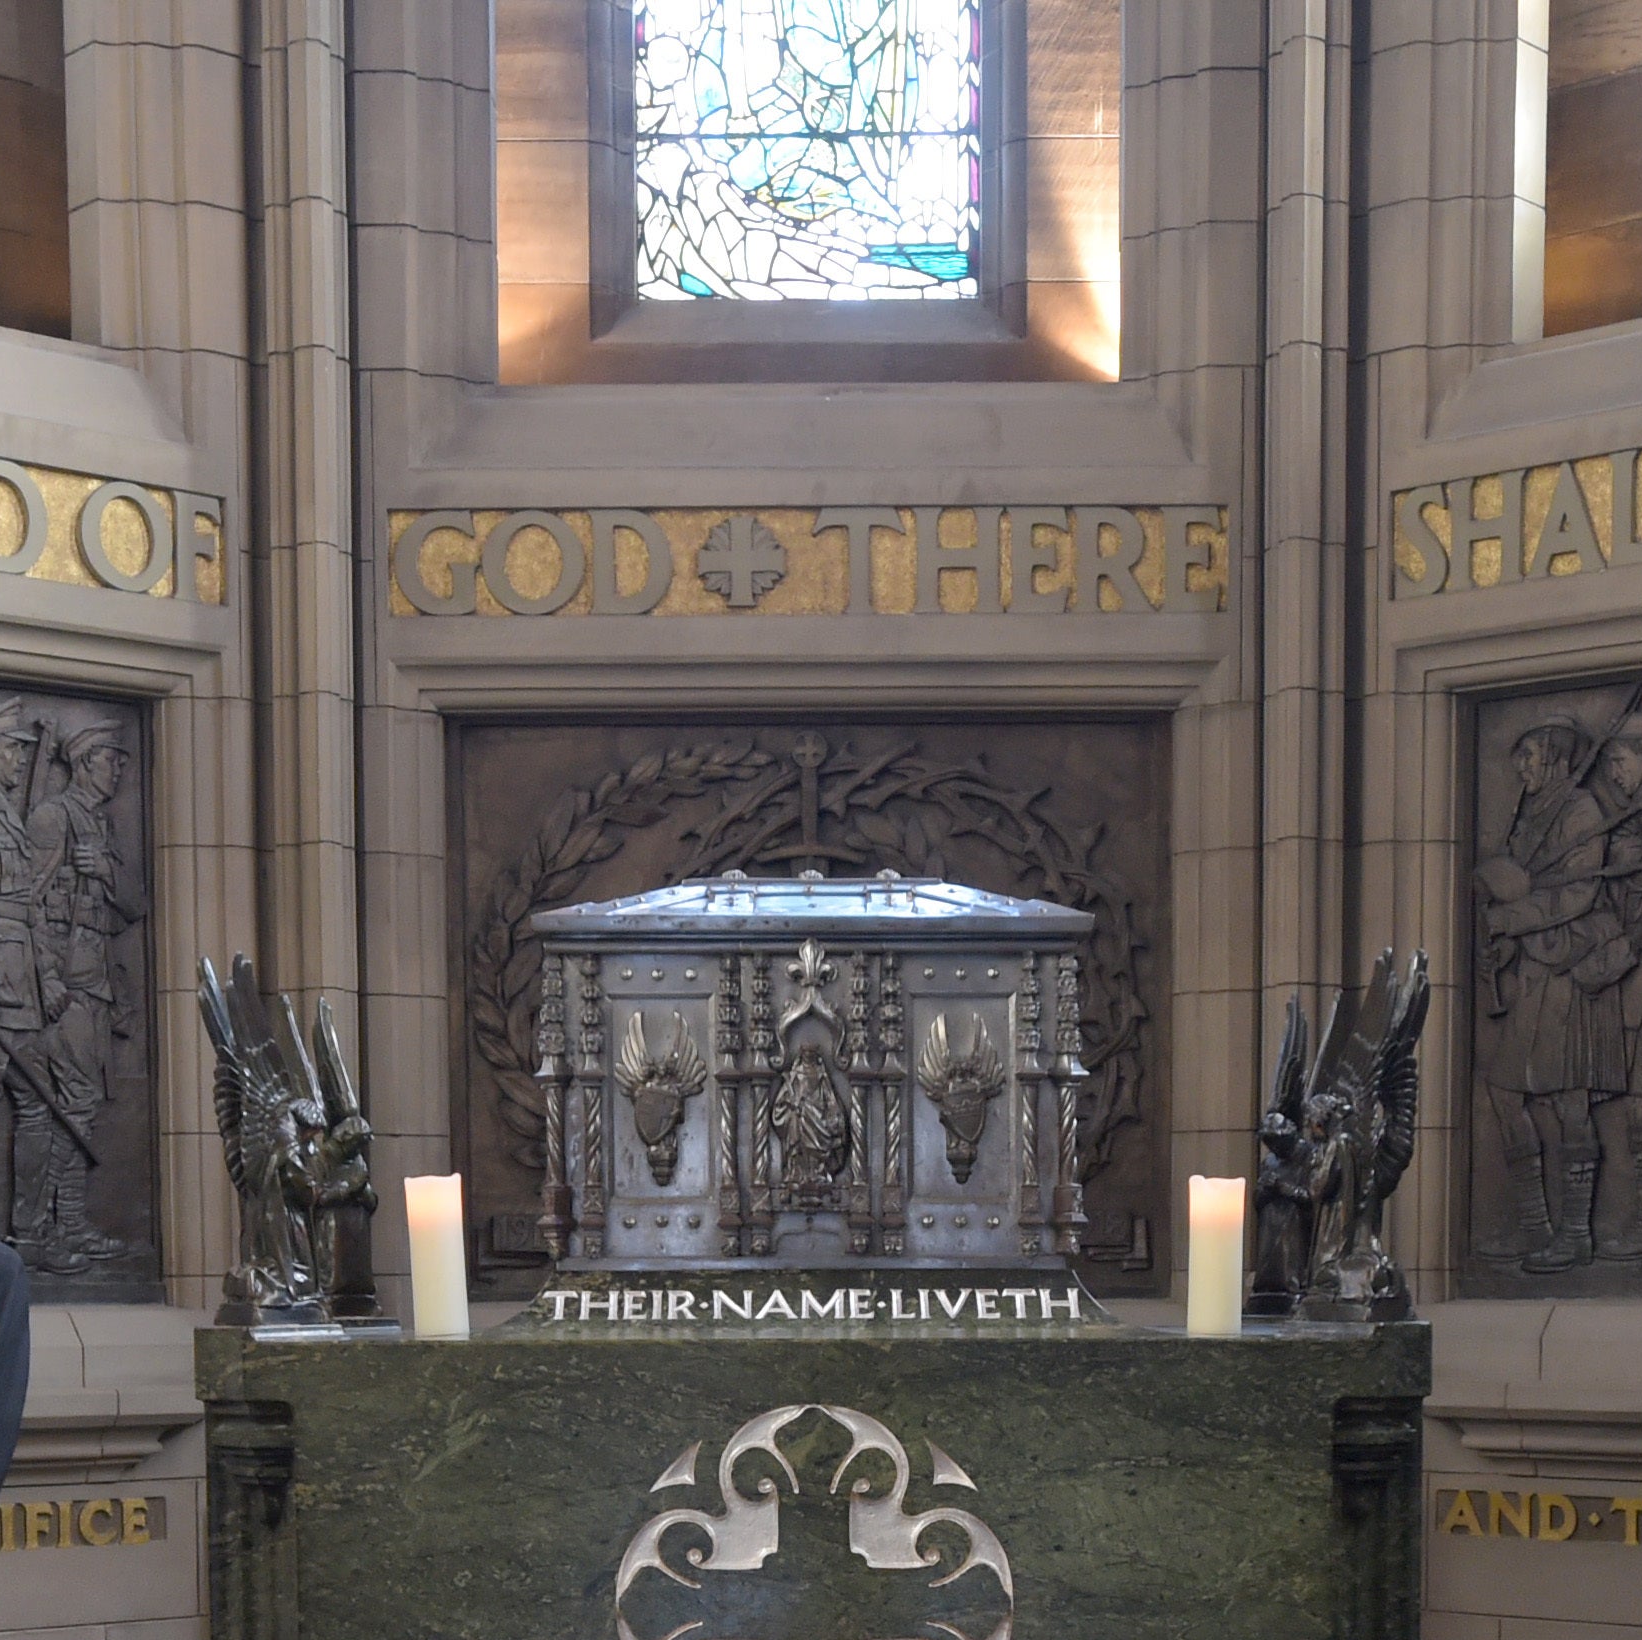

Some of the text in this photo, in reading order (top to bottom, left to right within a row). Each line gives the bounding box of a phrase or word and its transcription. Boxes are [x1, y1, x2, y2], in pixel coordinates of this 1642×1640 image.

[79, 478, 221, 602] OF
[392, 504, 1223, 617] GOD THERE
[890, 1286, 1083, 1320] LIVETH
[1439, 1489, 1578, 1542] AND
